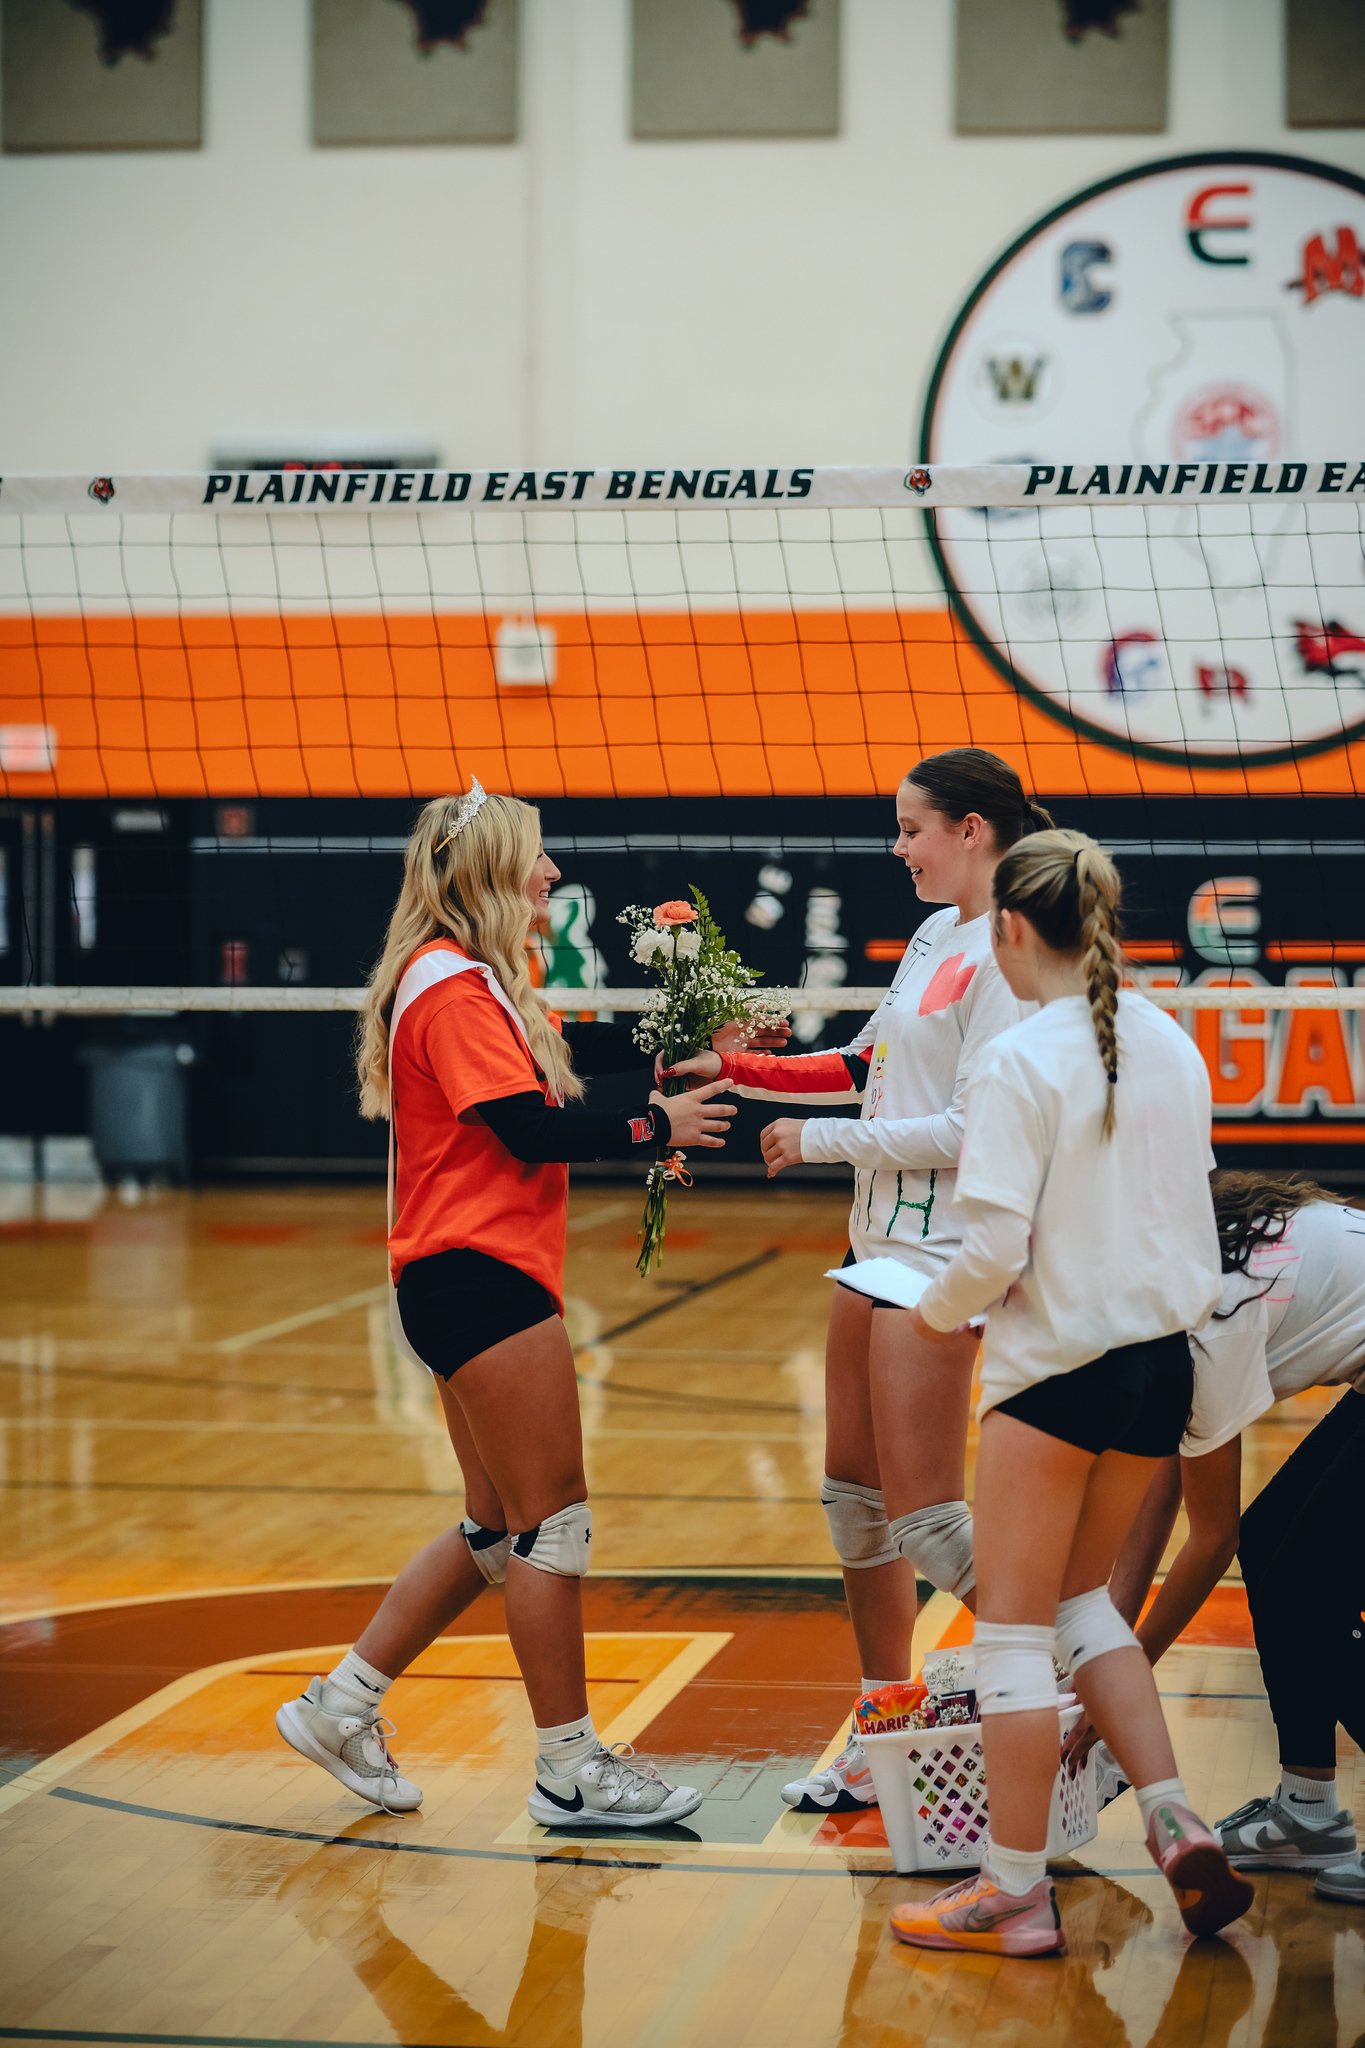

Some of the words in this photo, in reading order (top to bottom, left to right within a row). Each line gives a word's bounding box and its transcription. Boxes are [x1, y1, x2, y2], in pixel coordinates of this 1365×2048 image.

[203, 472, 472, 504] PLAINFIELD
[481, 470, 595, 501] EAST
[606, 469, 815, 499] BENGALS
[1023, 463, 1308, 496] PLAINFIELD
[863, 1713, 913, 1735] HARIB
